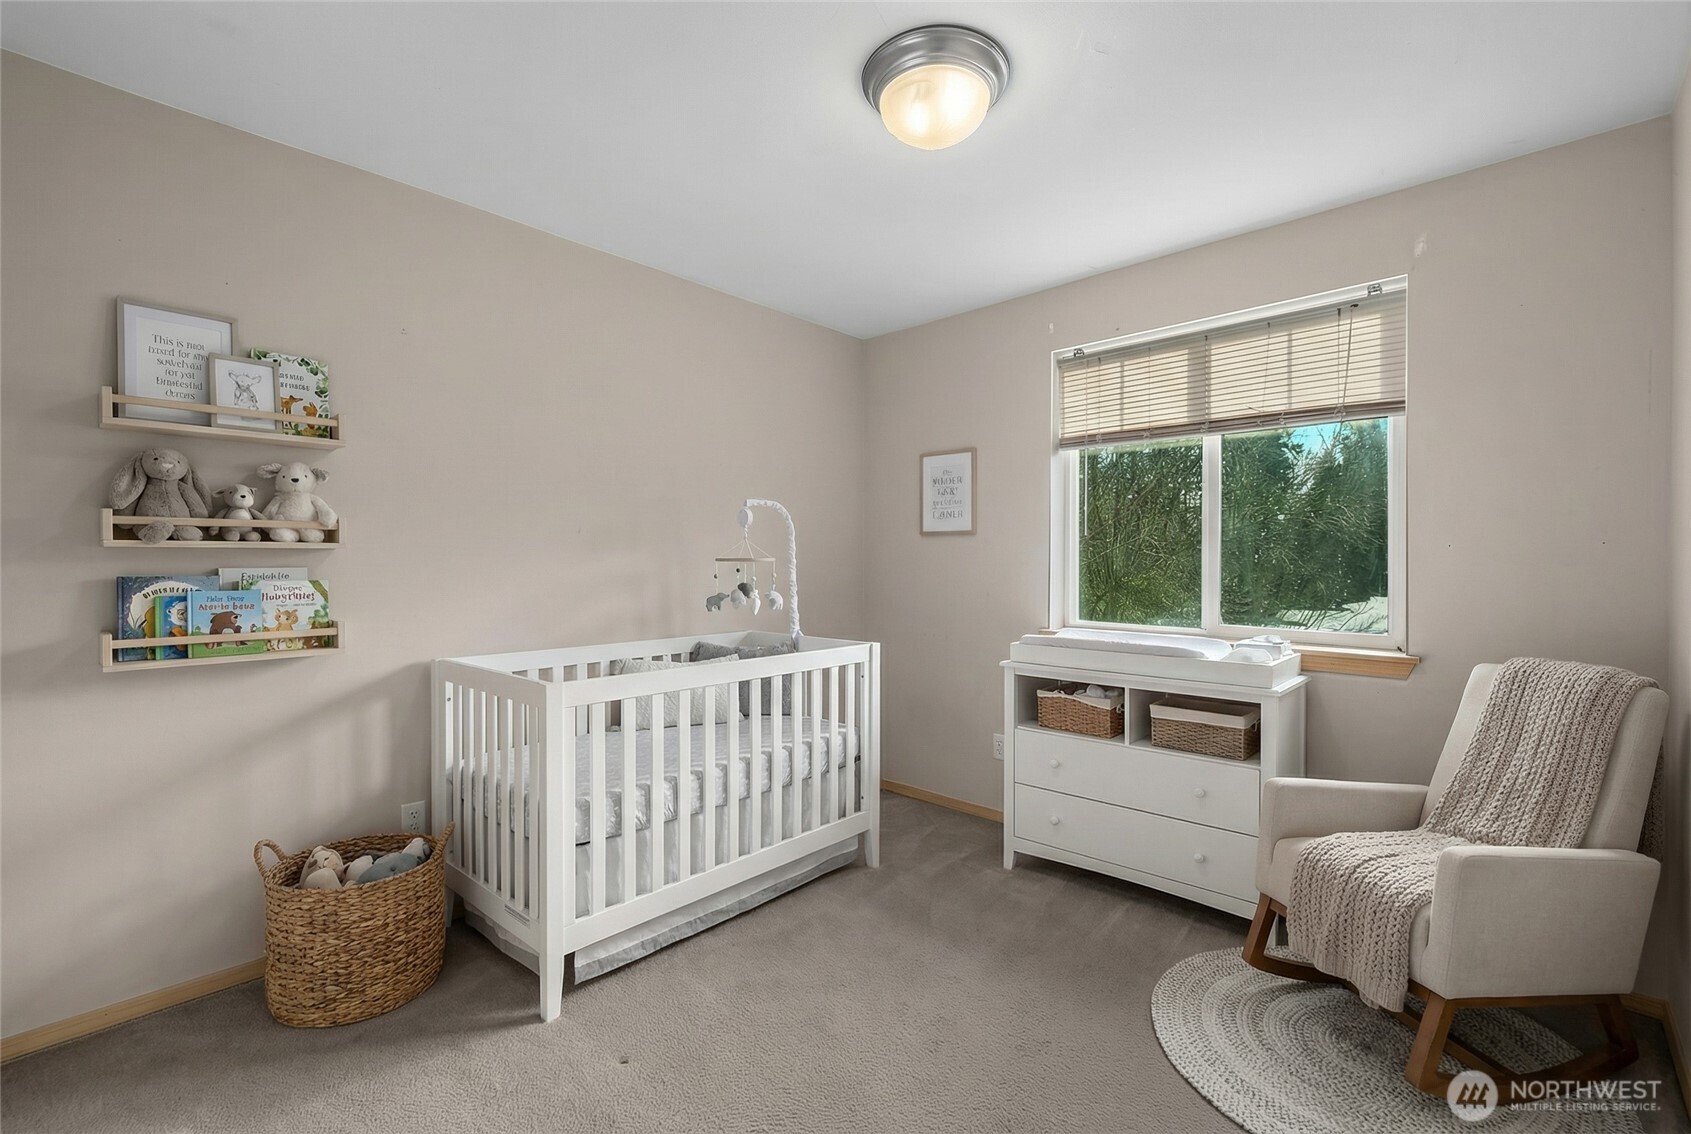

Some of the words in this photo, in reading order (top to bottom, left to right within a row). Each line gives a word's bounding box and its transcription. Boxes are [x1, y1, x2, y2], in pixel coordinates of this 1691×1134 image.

[152, 333, 174, 346] This
[176, 338, 184, 348] is
[178, 349, 191, 359] for
